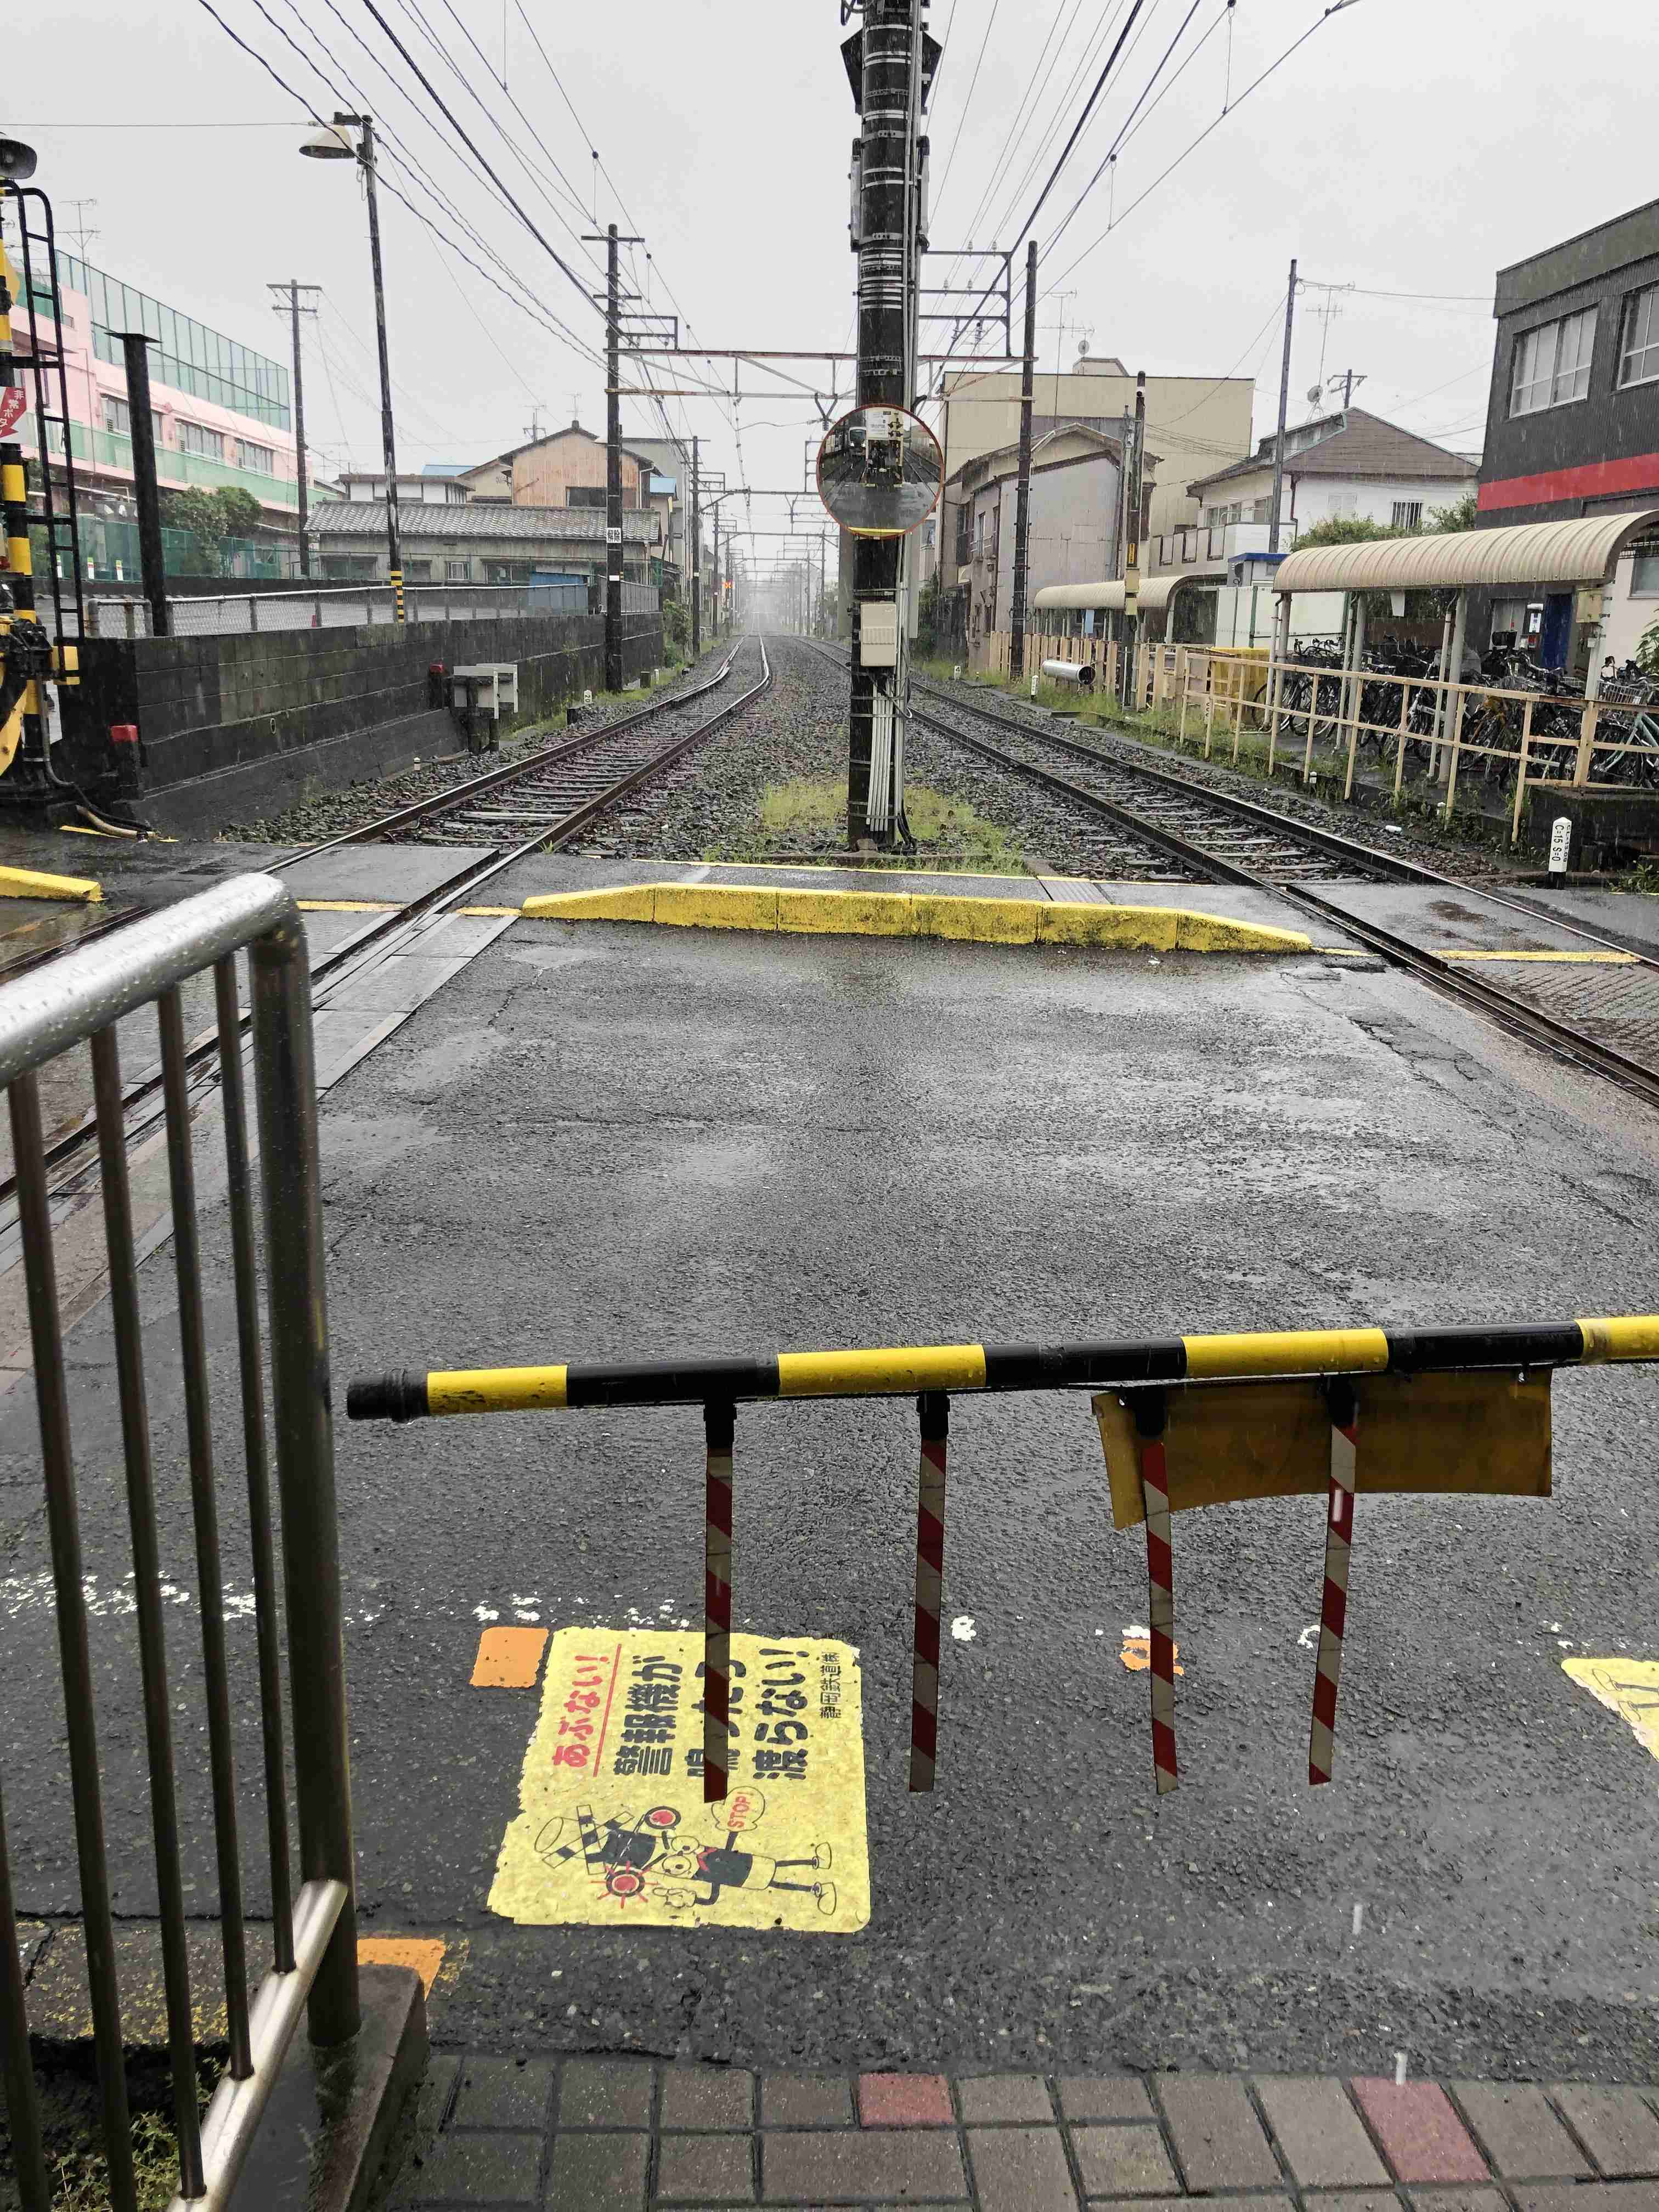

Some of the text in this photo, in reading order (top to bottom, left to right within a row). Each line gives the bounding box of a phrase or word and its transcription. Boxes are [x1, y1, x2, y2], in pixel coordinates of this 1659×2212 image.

[0, 390, 25, 435] 非常ボタ
[1551, 825, 1564, 861] C=15 S=0
[551, 1654, 608, 1769] あぶない!
[614, 1655, 682, 1776] 警報機が
[753, 1647, 810, 1780] 渡らない!
[727, 1791, 754, 1827] STOP!
